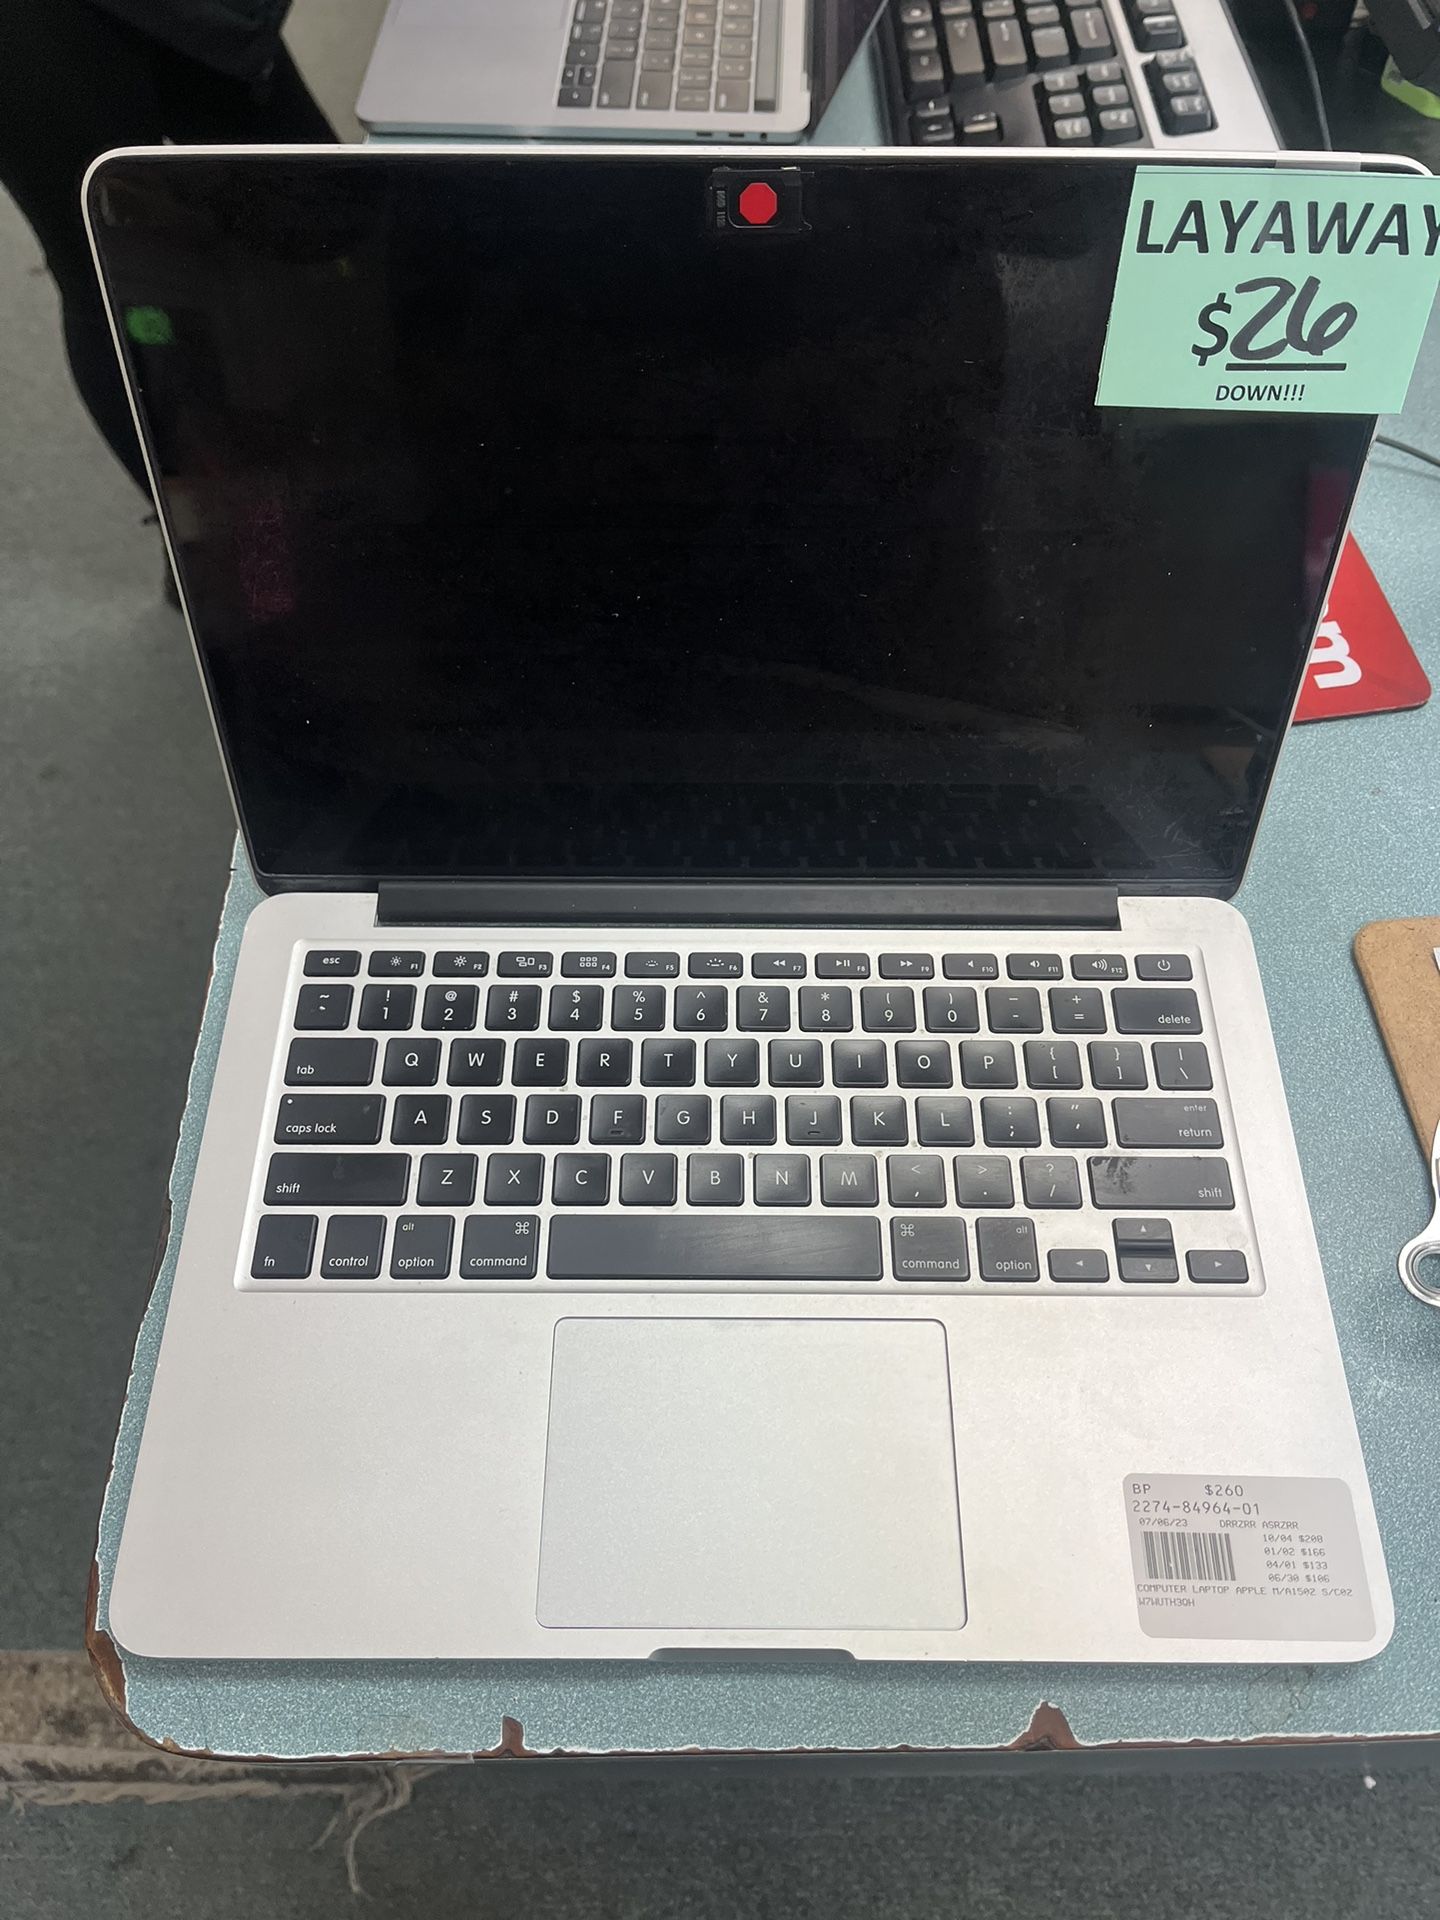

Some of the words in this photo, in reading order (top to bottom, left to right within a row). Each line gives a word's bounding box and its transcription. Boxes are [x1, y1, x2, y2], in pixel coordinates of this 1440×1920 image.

[1191, 275, 1358, 367] $26
[1215, 383, 1306, 402] DOWN!!!
[322, 957, 341, 965] esc
[473, 963, 483, 971] F2
[665, 964, 675, 972] F5
[383, 1006, 389, 1020] 1
[443, 1007, 454, 1021] 2
[507, 1007, 517, 1021] 3
[569, 1008, 580, 1021] 4
[633, 1008, 643, 1021] 5
[696, 1008, 706, 1021] 6
[759, 1008, 768, 1021] 7
[821, 1008, 831, 1022] 8
[884, 1009, 894, 1022] 9
[947, 1009, 958, 1023] 0
[1157, 1014, 1192, 1024] delete
[404, 1052, 419, 1067] Q
[468, 1052, 485, 1067] W
[535, 1052, 545, 1067] E
[600, 1053, 610, 1067] R
[663, 1053, 674, 1068] T
[727, 1053, 738, 1068] Y
[789, 1053, 802, 1068] U
[917, 1054, 931, 1069] O
[983, 1055, 994, 1070] P
[296, 1064, 315, 1075] tab
[1183, 1104, 1207, 1112] enter
[414, 1109, 427, 1125] A
[481, 1110, 492, 1125] S
[546, 1110, 559, 1125] D
[614, 1110, 623, 1125] F
[676, 1110, 690, 1125] G
[742, 1110, 755, 1125] H
[809, 1110, 817, 1126] J
[873, 1111, 886, 1126] K
[940, 1112, 950, 1127] L
[285, 1125, 312, 1135] caps
[314, 1122, 337, 1133] lock
[1178, 1127, 1213, 1137] return
[441, 1169, 454, 1185] Z
[507, 1169, 521, 1185] X
[575, 1169, 588, 1185] C
[642, 1169, 655, 1185] V
[710, 1170, 721, 1185] B
[775, 1170, 788, 1185] N
[840, 1170, 858, 1186] M
[275, 1182, 301, 1193] shift
[1198, 1187, 1223, 1198] shift
[402, 1222, 415, 1231] alt
[1015, 1225, 1028, 1234] alt
[264, 1255, 275, 1267] fn
[328, 1255, 369, 1267] control
[397, 1256, 435, 1270] option
[469, 1255, 528, 1267] command
[902, 1258, 960, 1270] command
[995, 1259, 1032, 1273] option
[1132, 1483, 1151, 1495] BP
[1204, 1484, 1244, 1497] $260
[1132, 1499, 1260, 1516] 2274-84964-01
[1138, 1517, 1189, 1528] 07/06/23
[1262, 1533, 1293, 1543] 10/04
[1263, 1546, 1296, 1557] 01/02
[1300, 1547, 1326, 1557] $166
[1265, 1559, 1296, 1570] 04/01
[1302, 1560, 1328, 1570] $133
[1267, 1572, 1300, 1583] 06/30
[1136, 1583, 1188, 1594] COMPUTER
[1191, 1584, 1230, 1594] LAPTOP
[1235, 1586, 1266, 1596] APPLE
